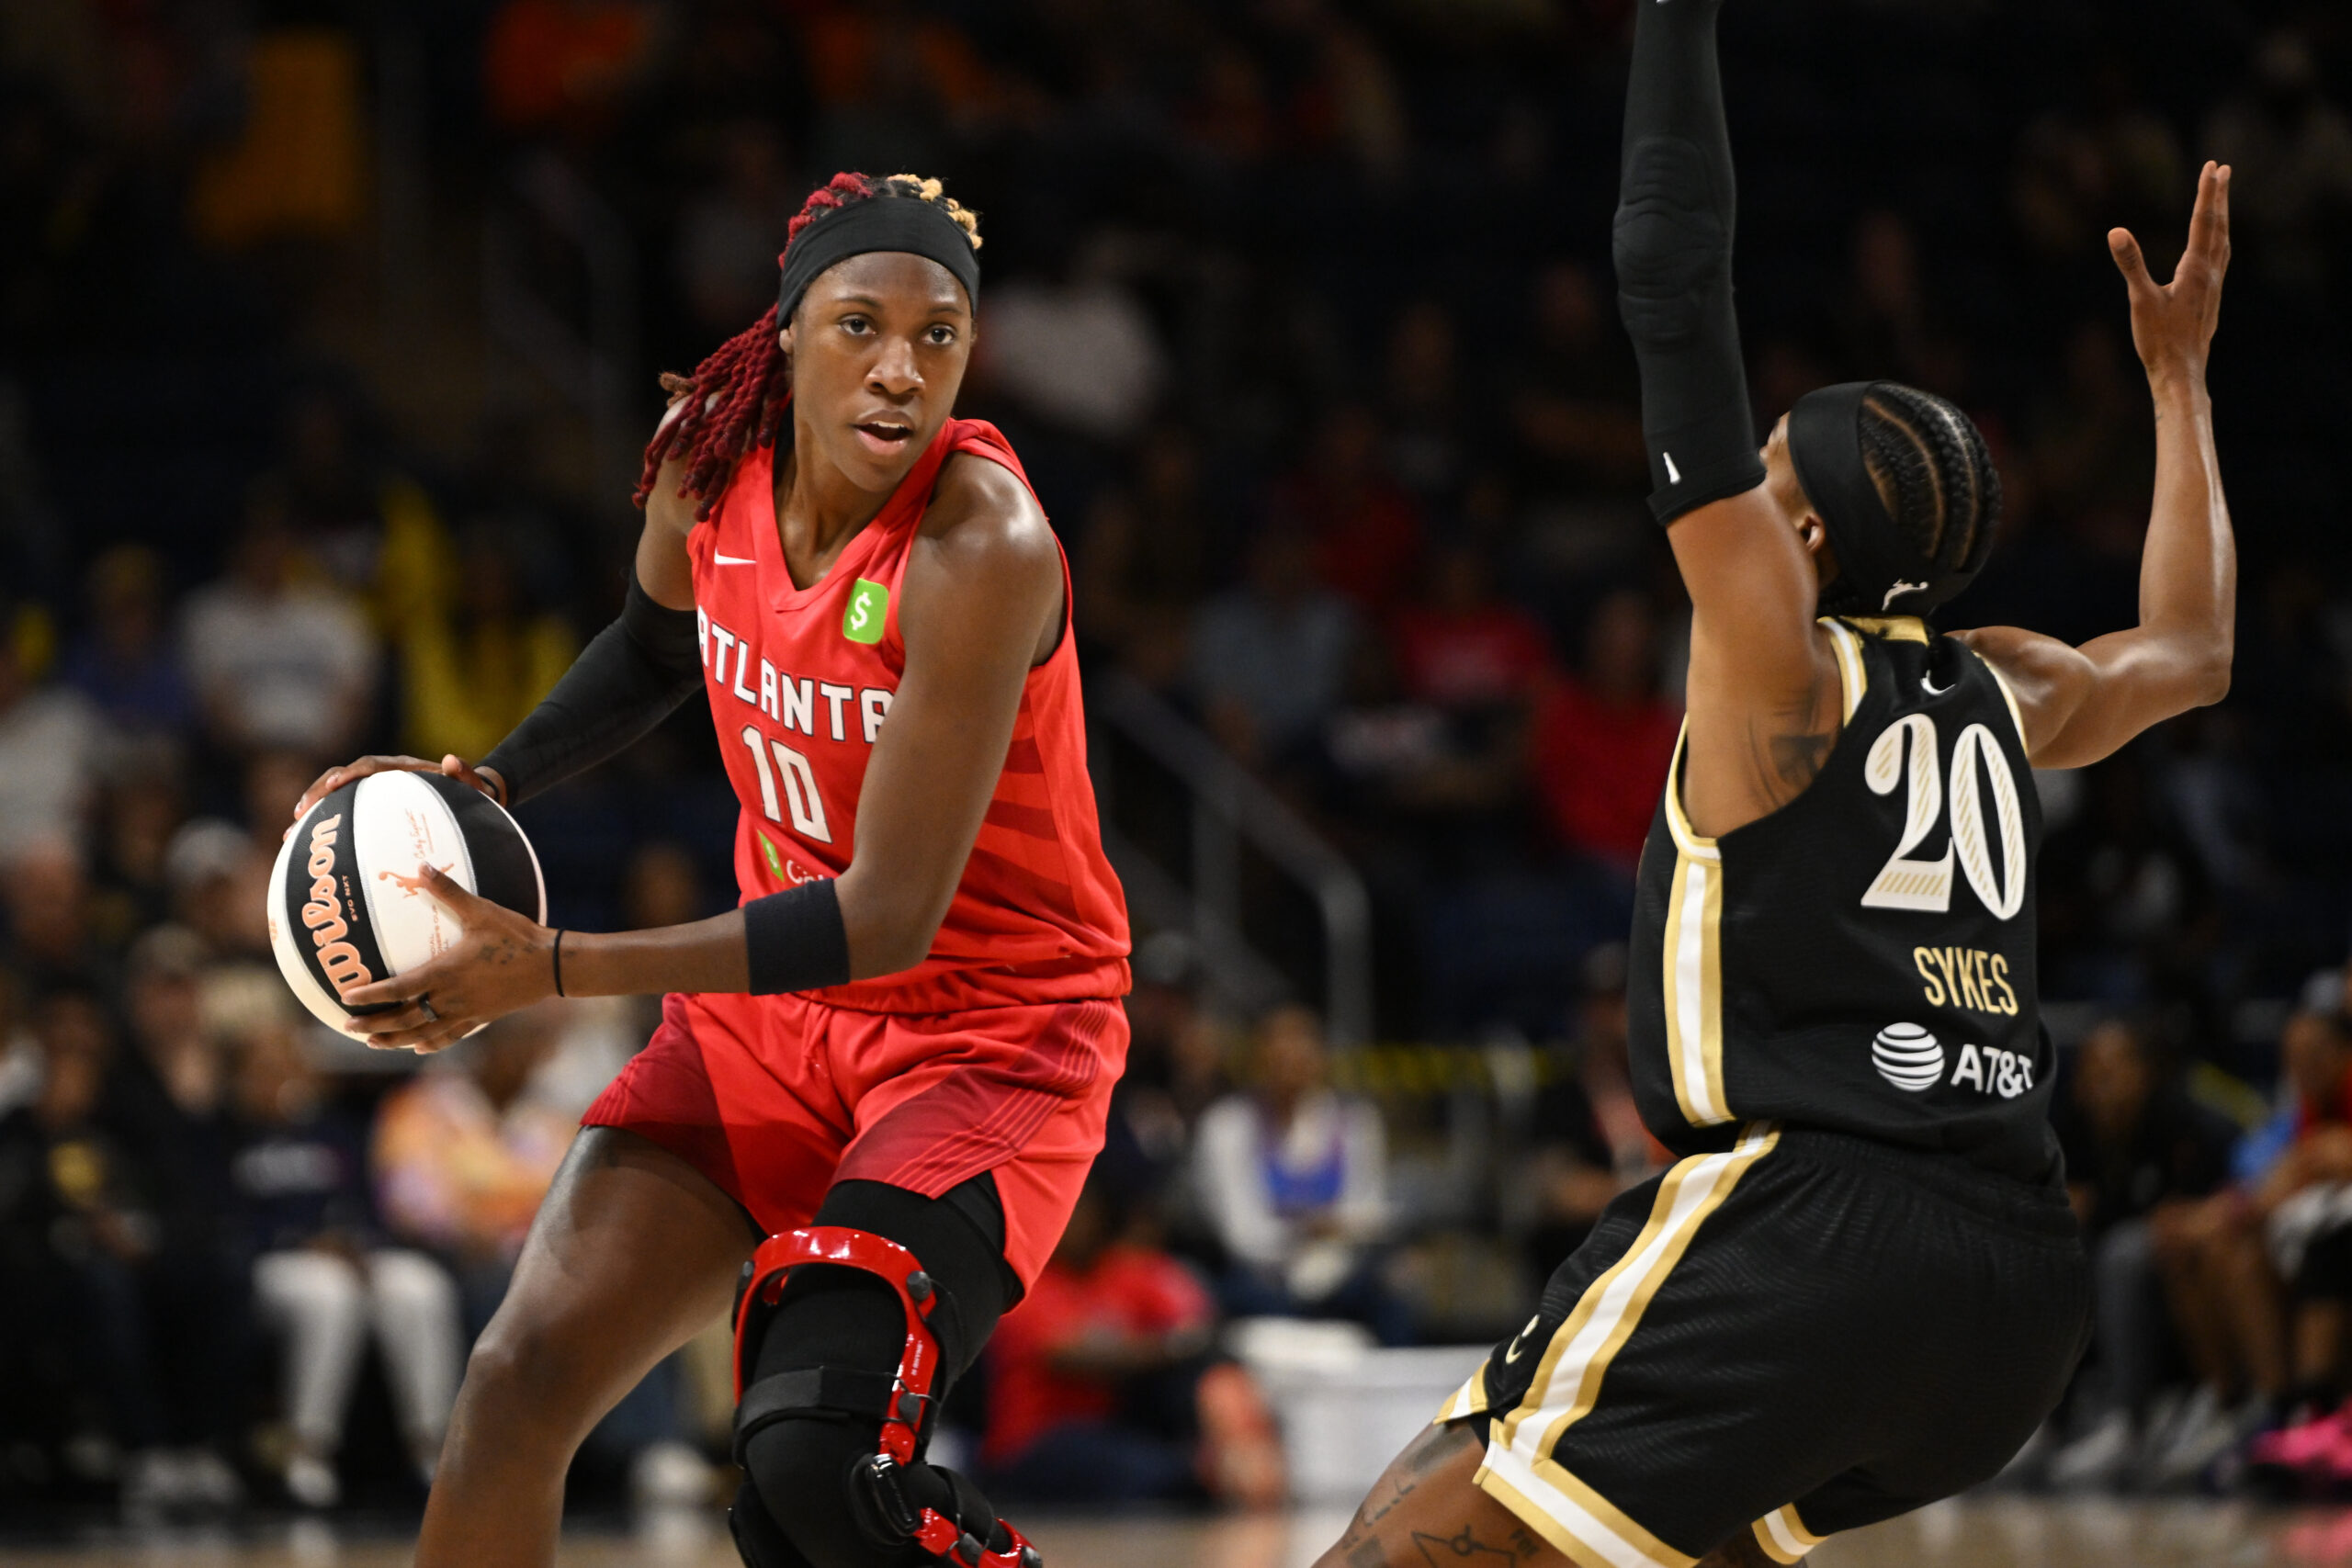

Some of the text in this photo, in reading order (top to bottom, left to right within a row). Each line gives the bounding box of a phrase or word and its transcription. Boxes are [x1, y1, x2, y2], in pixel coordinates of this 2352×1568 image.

[697, 604, 894, 744] ATLANTA
[741, 725, 833, 844] 10
[1860, 713, 2027, 921] 20
[301, 813, 372, 1001] Wilson
[1913, 946, 2019, 1017] SYKES
[1950, 1043, 2034, 1100] AT&T
